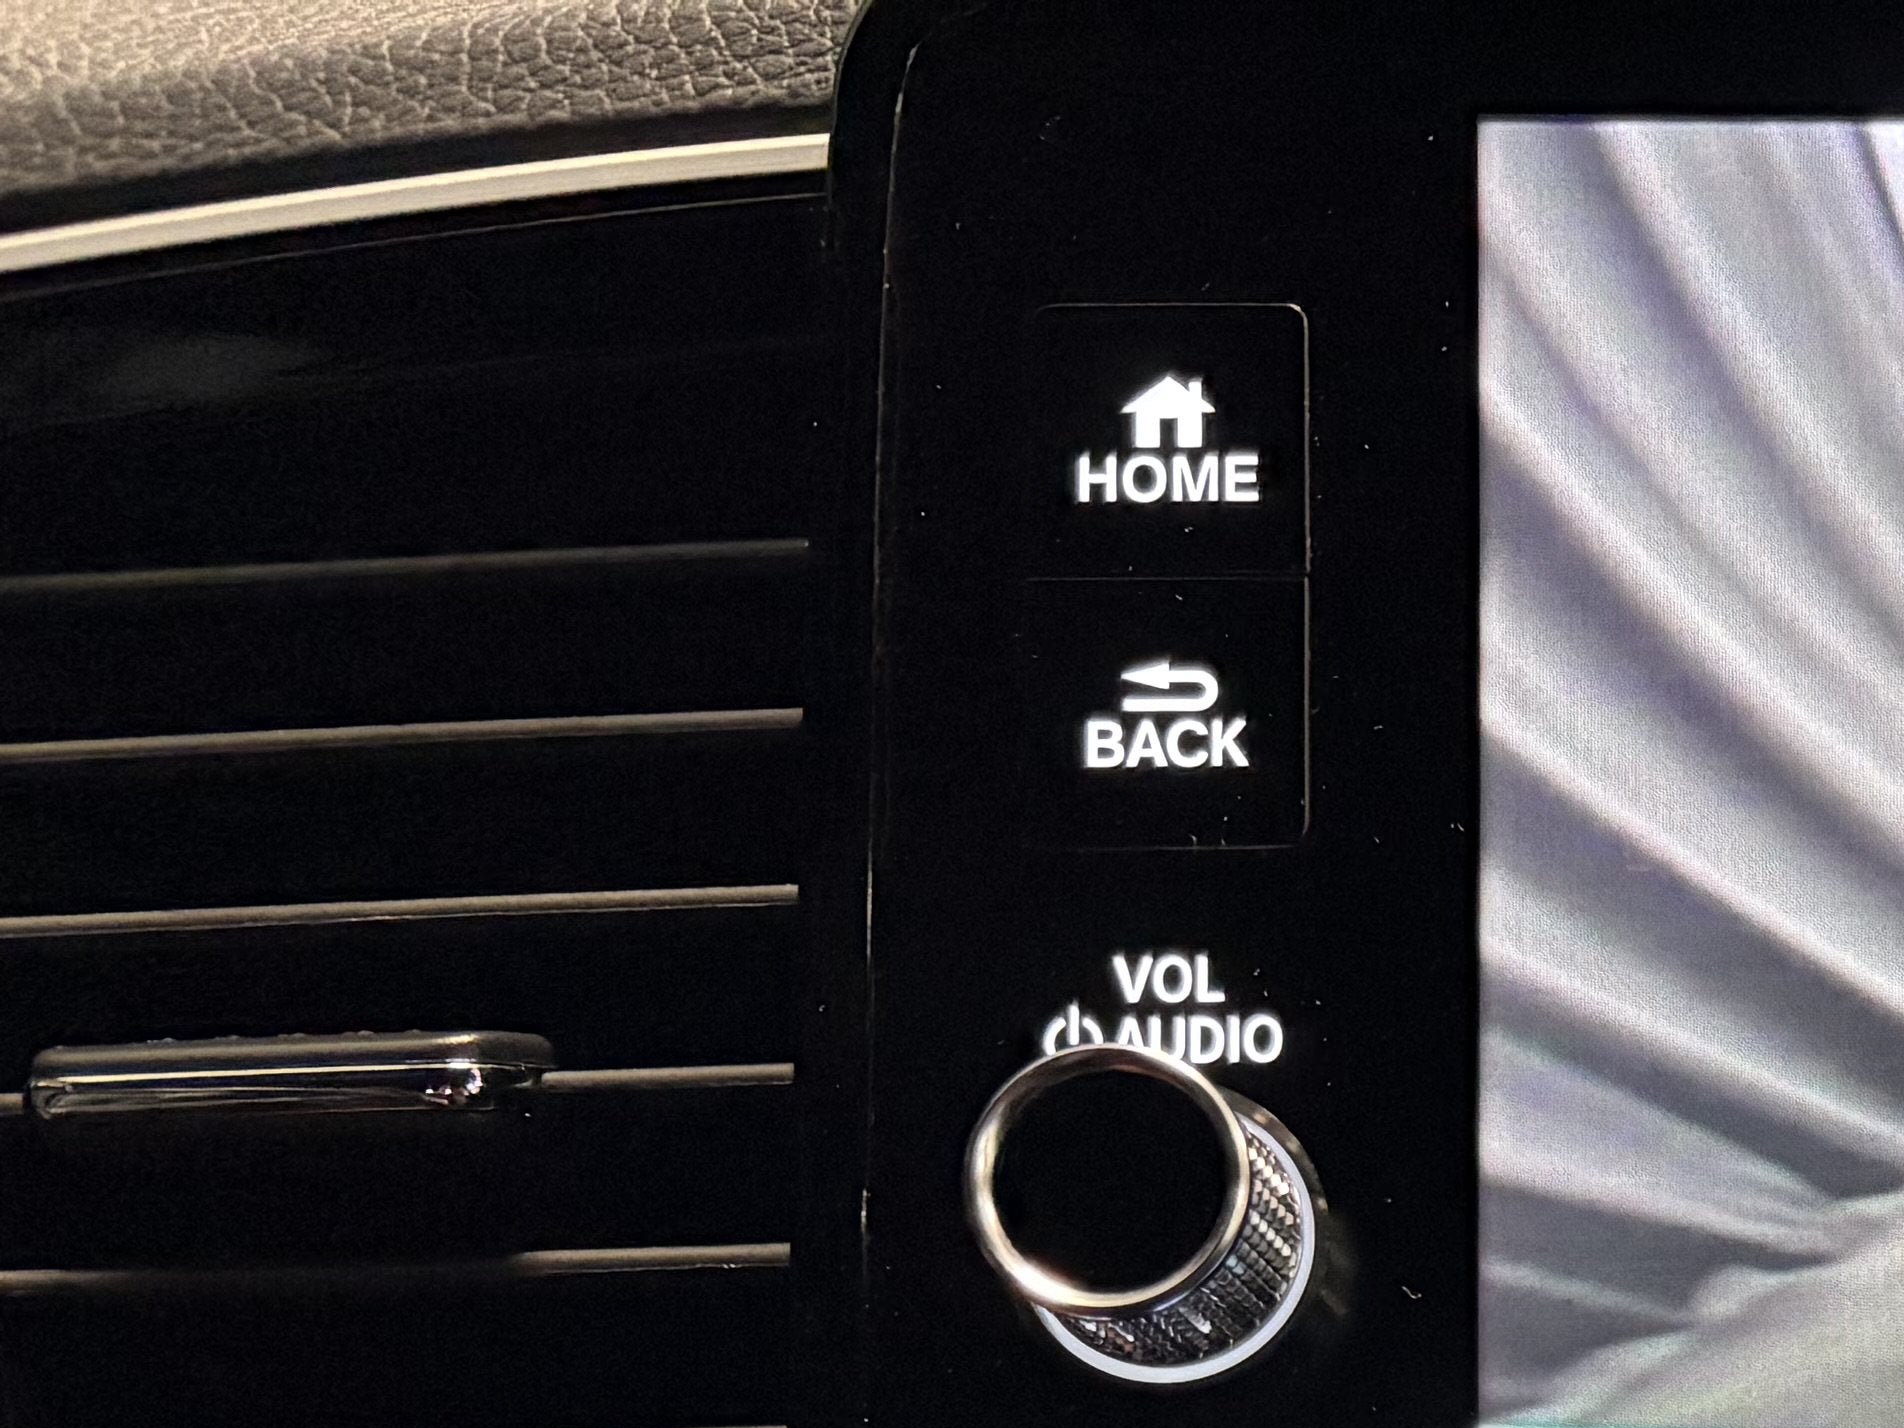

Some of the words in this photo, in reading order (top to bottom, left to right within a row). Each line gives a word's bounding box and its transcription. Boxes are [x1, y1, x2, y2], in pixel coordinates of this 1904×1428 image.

[1074, 450, 1262, 506] HOME
[1081, 714, 1252, 770] BACK
[1110, 951, 1228, 1005] VOL
